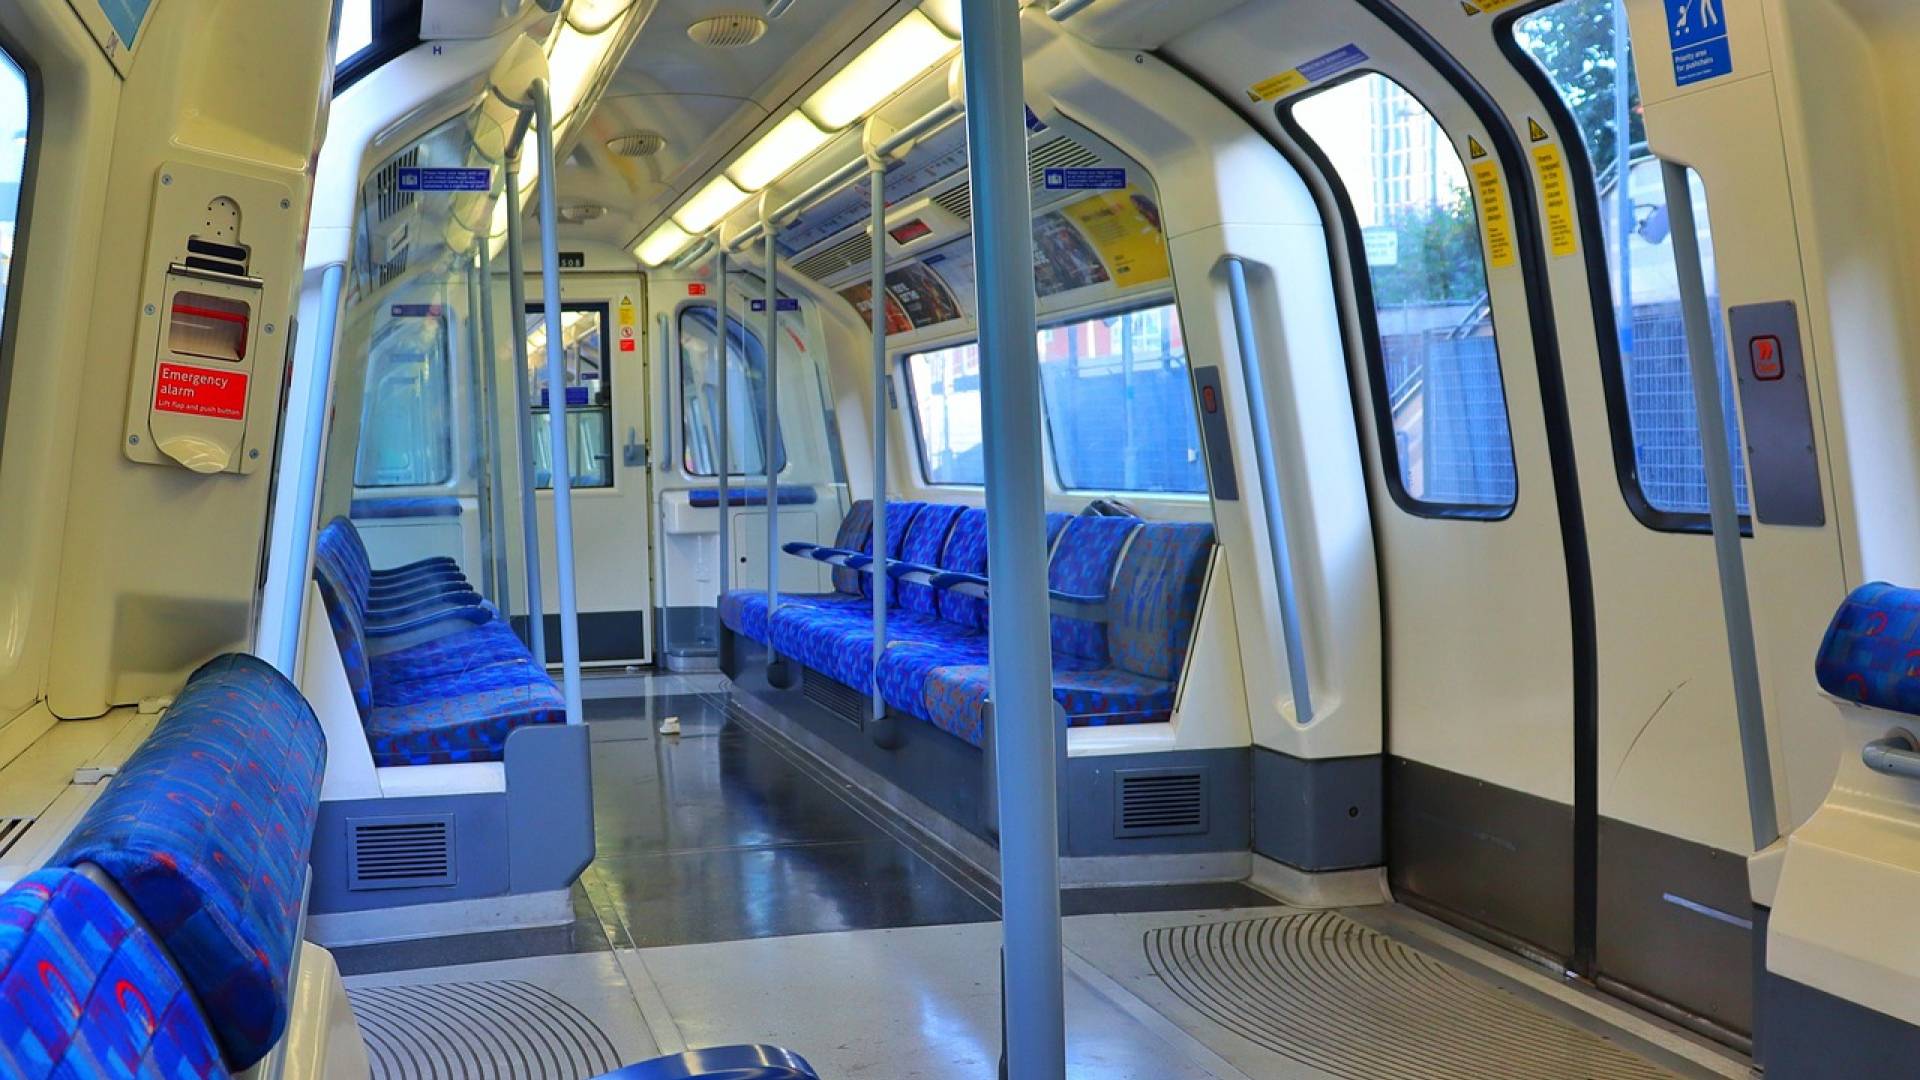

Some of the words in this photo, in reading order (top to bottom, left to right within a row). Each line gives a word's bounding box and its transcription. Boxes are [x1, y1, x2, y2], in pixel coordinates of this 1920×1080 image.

[433, 45, 442, 55] H
[1135, 55, 1144, 64] G
[162, 367, 228, 389] Emergency
[160, 384, 194, 397] alarm
[158, 399, 170, 407] Lift
[171, 400, 185, 409] flap
[186, 403, 198, 411] and
[200, 405, 216, 414] push
[217, 406, 240, 415] button
